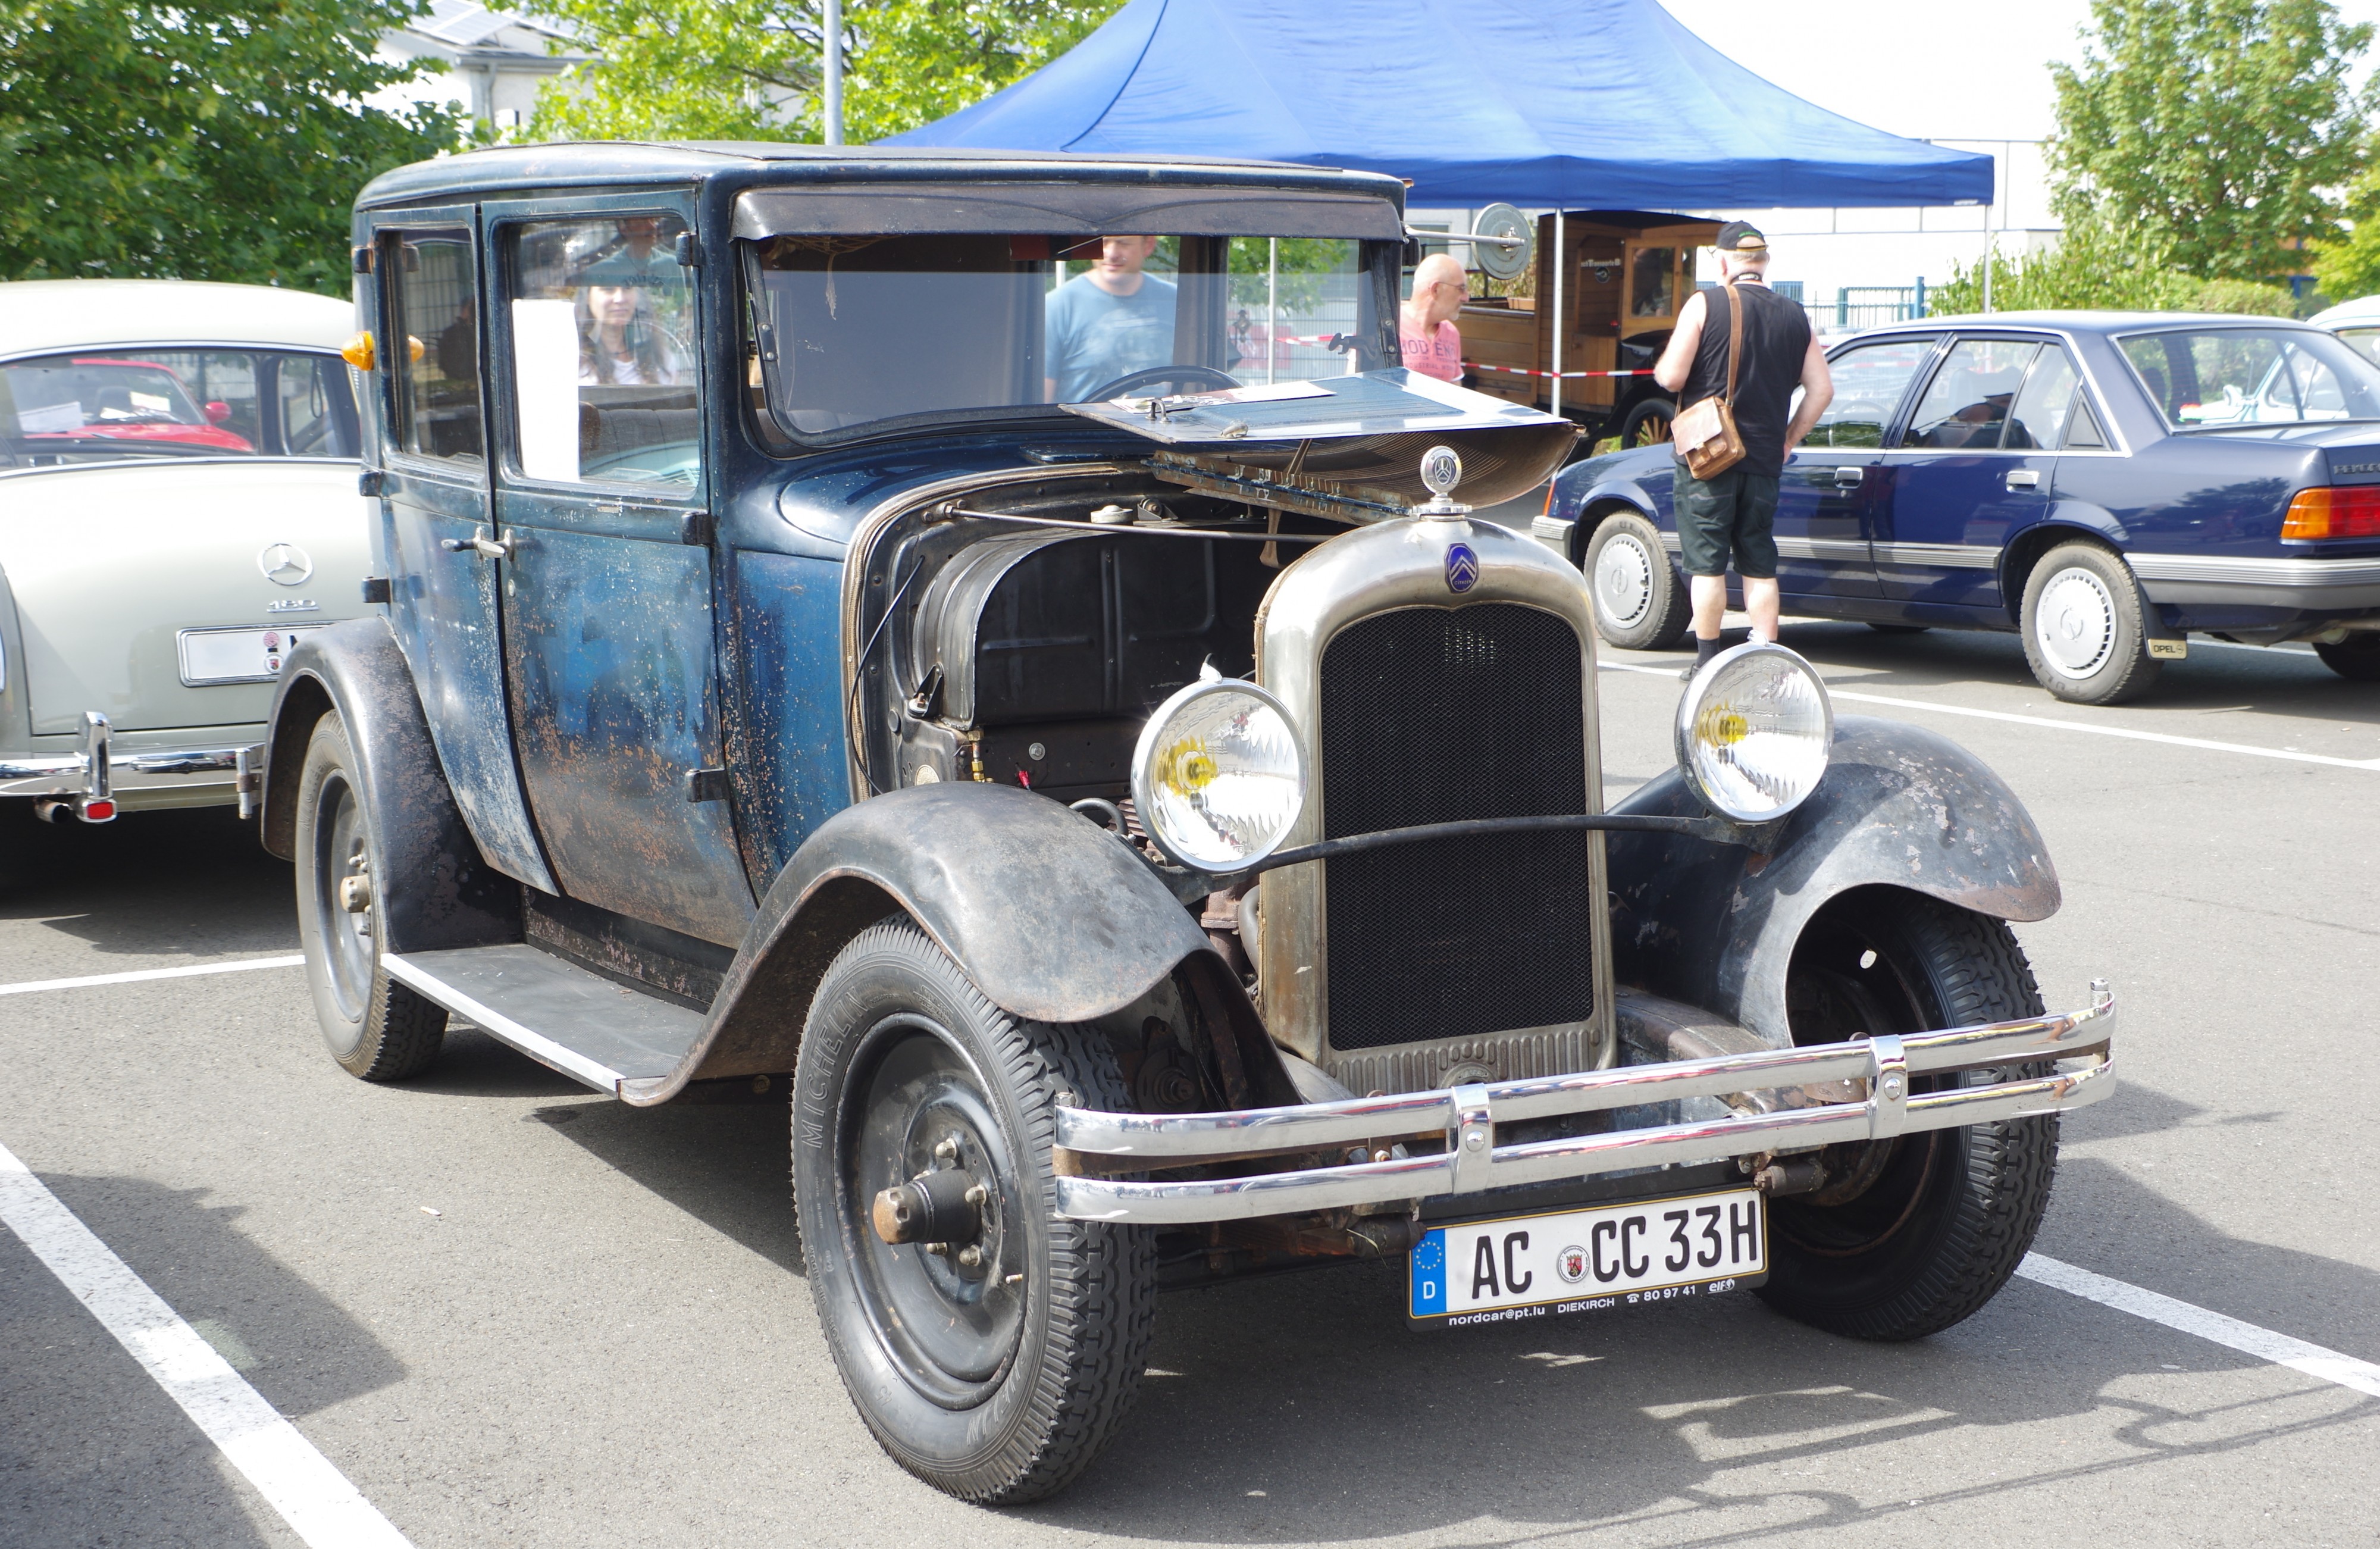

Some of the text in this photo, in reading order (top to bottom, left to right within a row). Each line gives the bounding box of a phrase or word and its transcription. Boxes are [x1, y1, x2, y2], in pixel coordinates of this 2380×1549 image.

[2334, 464, 2380, 474] REKOR
[268, 600, 316, 609] 180
[801, 986, 868, 1149] MICHELIN
[1471, 1231, 1532, 1300] AC
[1591, 1215, 1649, 1282] CC
[1664, 1200, 1757, 1272] 33H
[808, 1245, 828, 1306] BIBENDUM
[1423, 1281, 1436, 1300] D
[1449, 1285, 1696, 1326] nordcar@pt.lu DIEKIRCH 80 97 41
[827, 1315, 850, 1363] CONFORT
